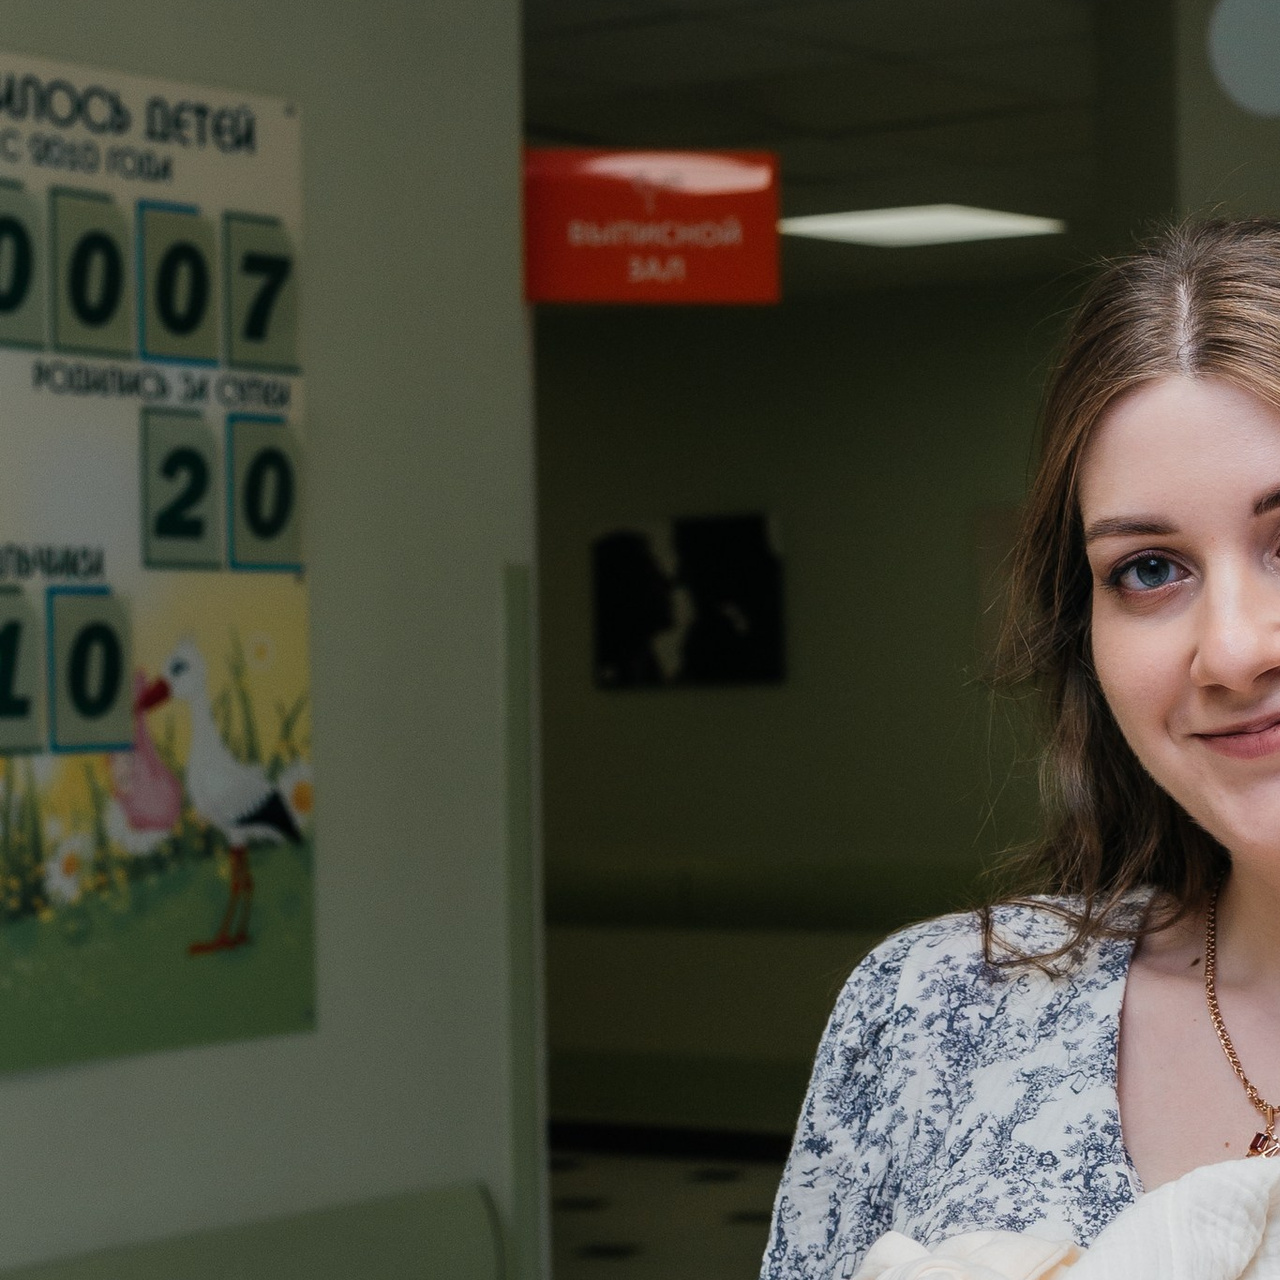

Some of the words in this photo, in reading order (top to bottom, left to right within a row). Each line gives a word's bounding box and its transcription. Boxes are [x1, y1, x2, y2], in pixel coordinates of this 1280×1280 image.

[145, 96, 258, 155] ДЕТЕЙ
[568, 214, 743, 248] ВЫПИСНОЙ
[628, 254, 687, 283] ЗАЛ
[154, 445, 296, 541] 20
